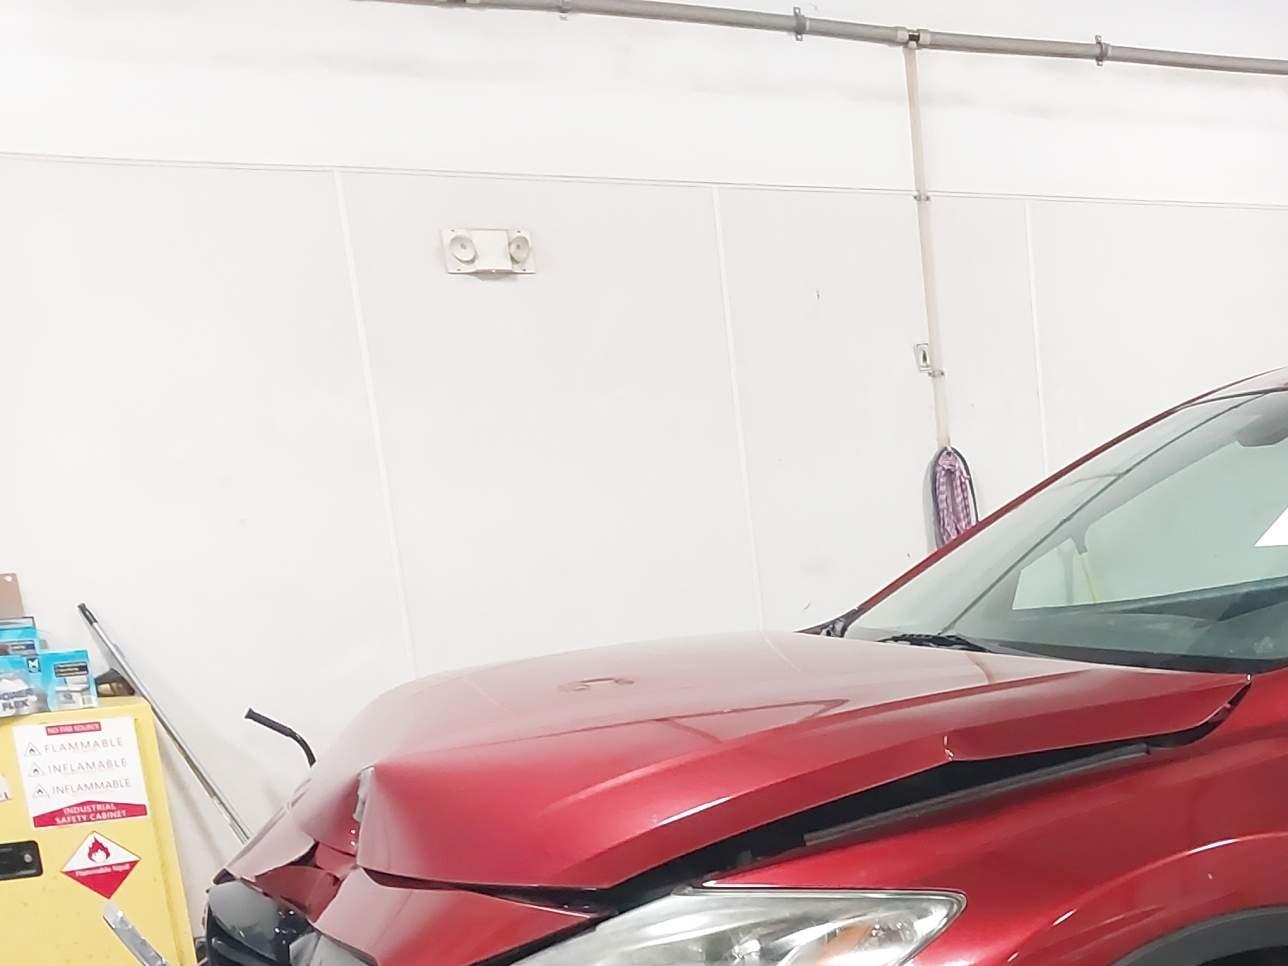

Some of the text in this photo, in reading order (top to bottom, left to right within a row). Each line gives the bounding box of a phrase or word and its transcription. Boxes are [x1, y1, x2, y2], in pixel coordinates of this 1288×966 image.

[2, 699, 30, 712] FLEX
[44, 737, 124, 754] FLAMMABLE
[48, 757, 128, 774] INFLAMABLE
[52, 778, 132, 795] INFLAMMABLE
[54, 809, 128, 825] SAFETY CABINET
[63, 803, 116, 815] INDUSTRIAL
